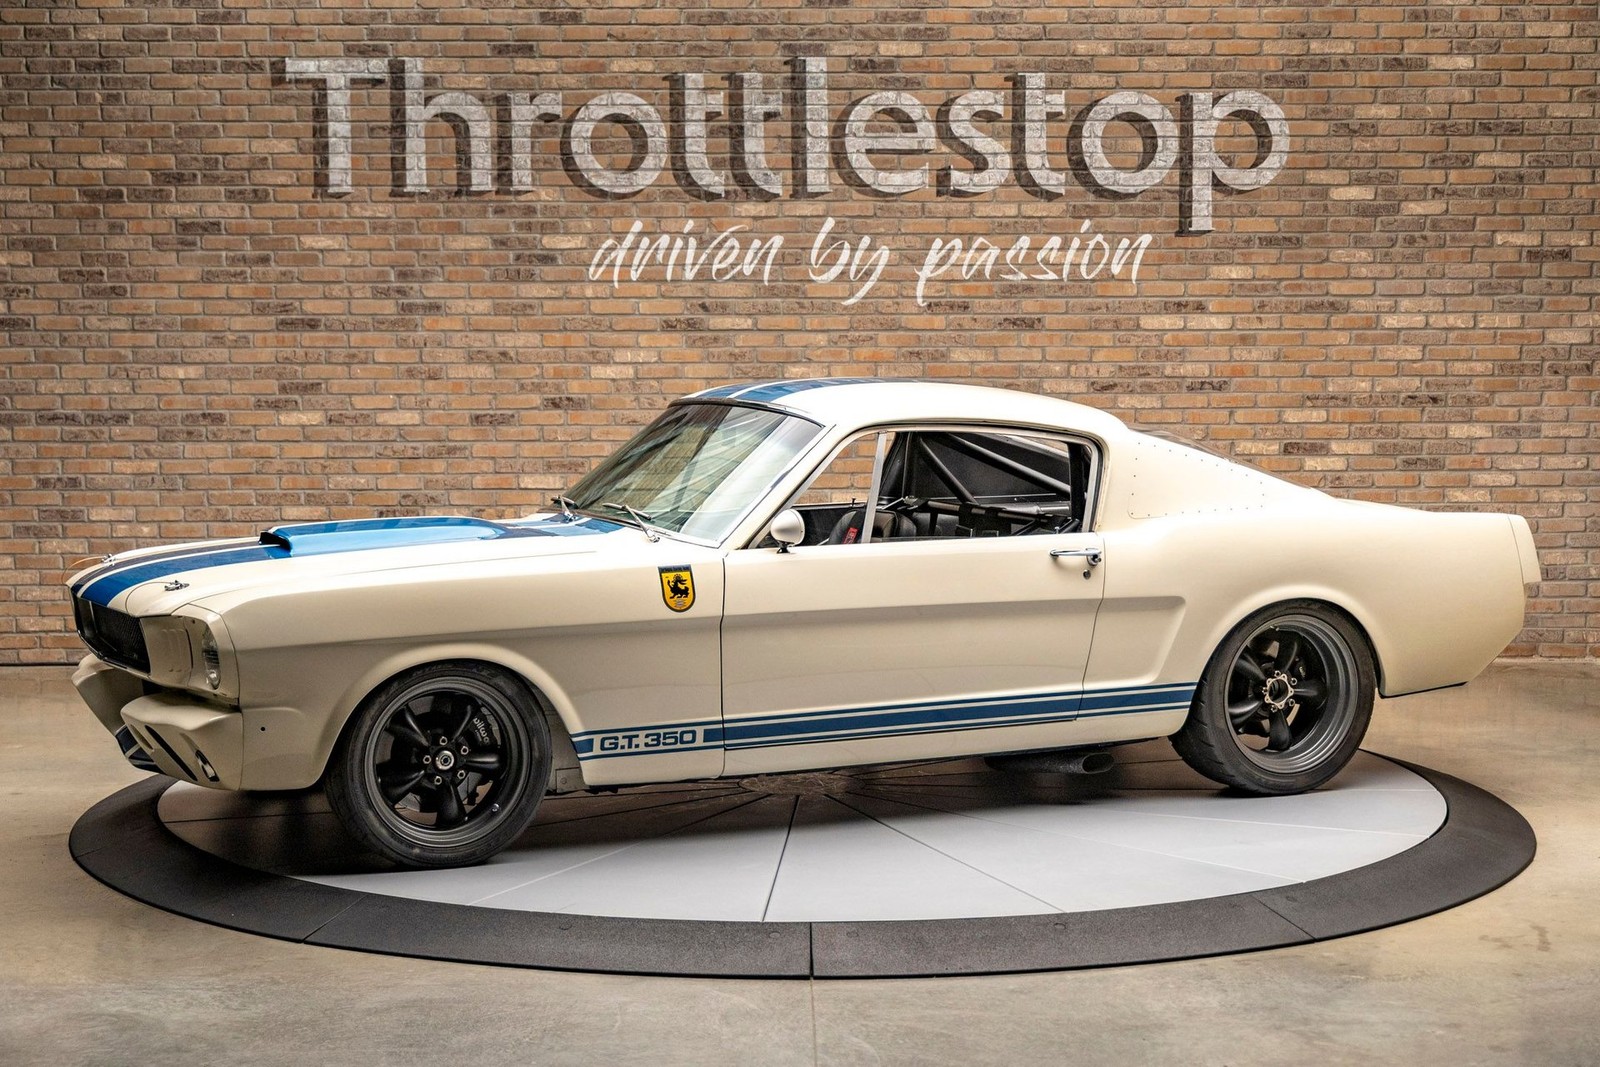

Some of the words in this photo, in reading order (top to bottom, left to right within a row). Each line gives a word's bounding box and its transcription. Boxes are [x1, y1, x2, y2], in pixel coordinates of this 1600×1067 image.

[277, 56, 1291, 234] Throttlestop
[588, 219, 785, 289] driven
[808, 217, 890, 306] by
[913, 219, 1153, 307] passion
